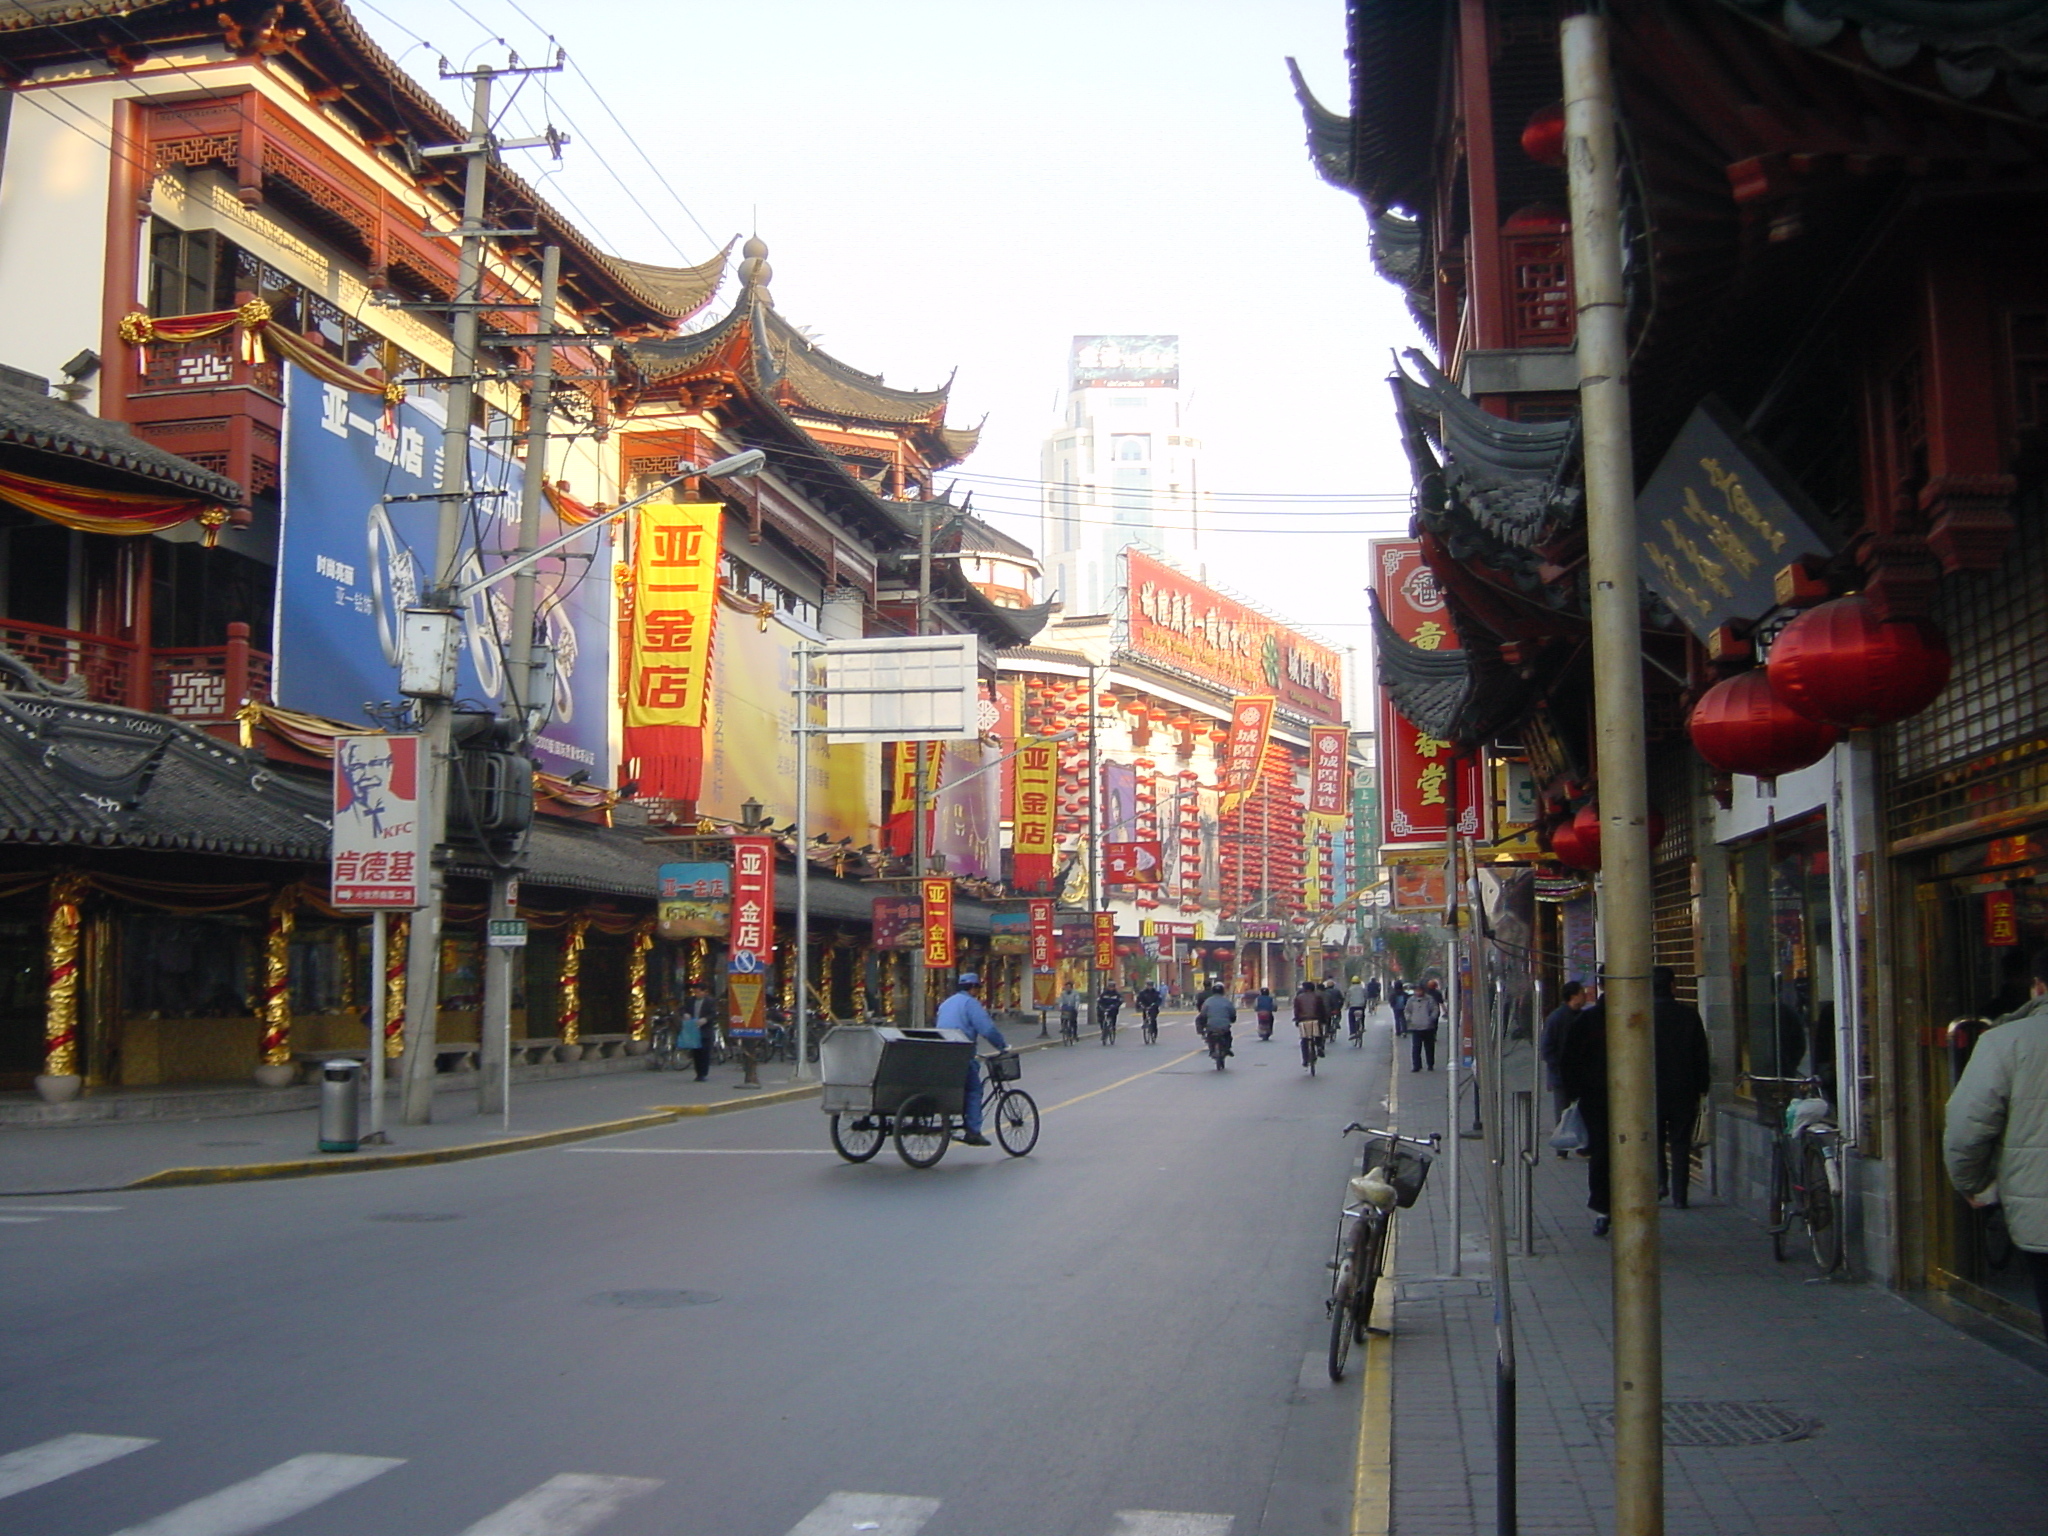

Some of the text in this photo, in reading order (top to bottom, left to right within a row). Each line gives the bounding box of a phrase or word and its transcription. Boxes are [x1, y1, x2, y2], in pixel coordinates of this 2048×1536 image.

[321, 382, 425, 479] 亚一金店
[638, 525, 703, 708] 亚一金店
[1019, 747, 1050, 844] 亚一金店
[382, 821, 415, 840] KFC
[335, 850, 416, 882] 肯德基
[661, 878, 725, 897] 亚一金店
[737, 853, 762, 948] 亚一金店
[928, 885, 946, 960] 亚一金店
[1033, 908, 1047, 960] 亚一金店
[1098, 916, 1110, 965] 亚一金店
